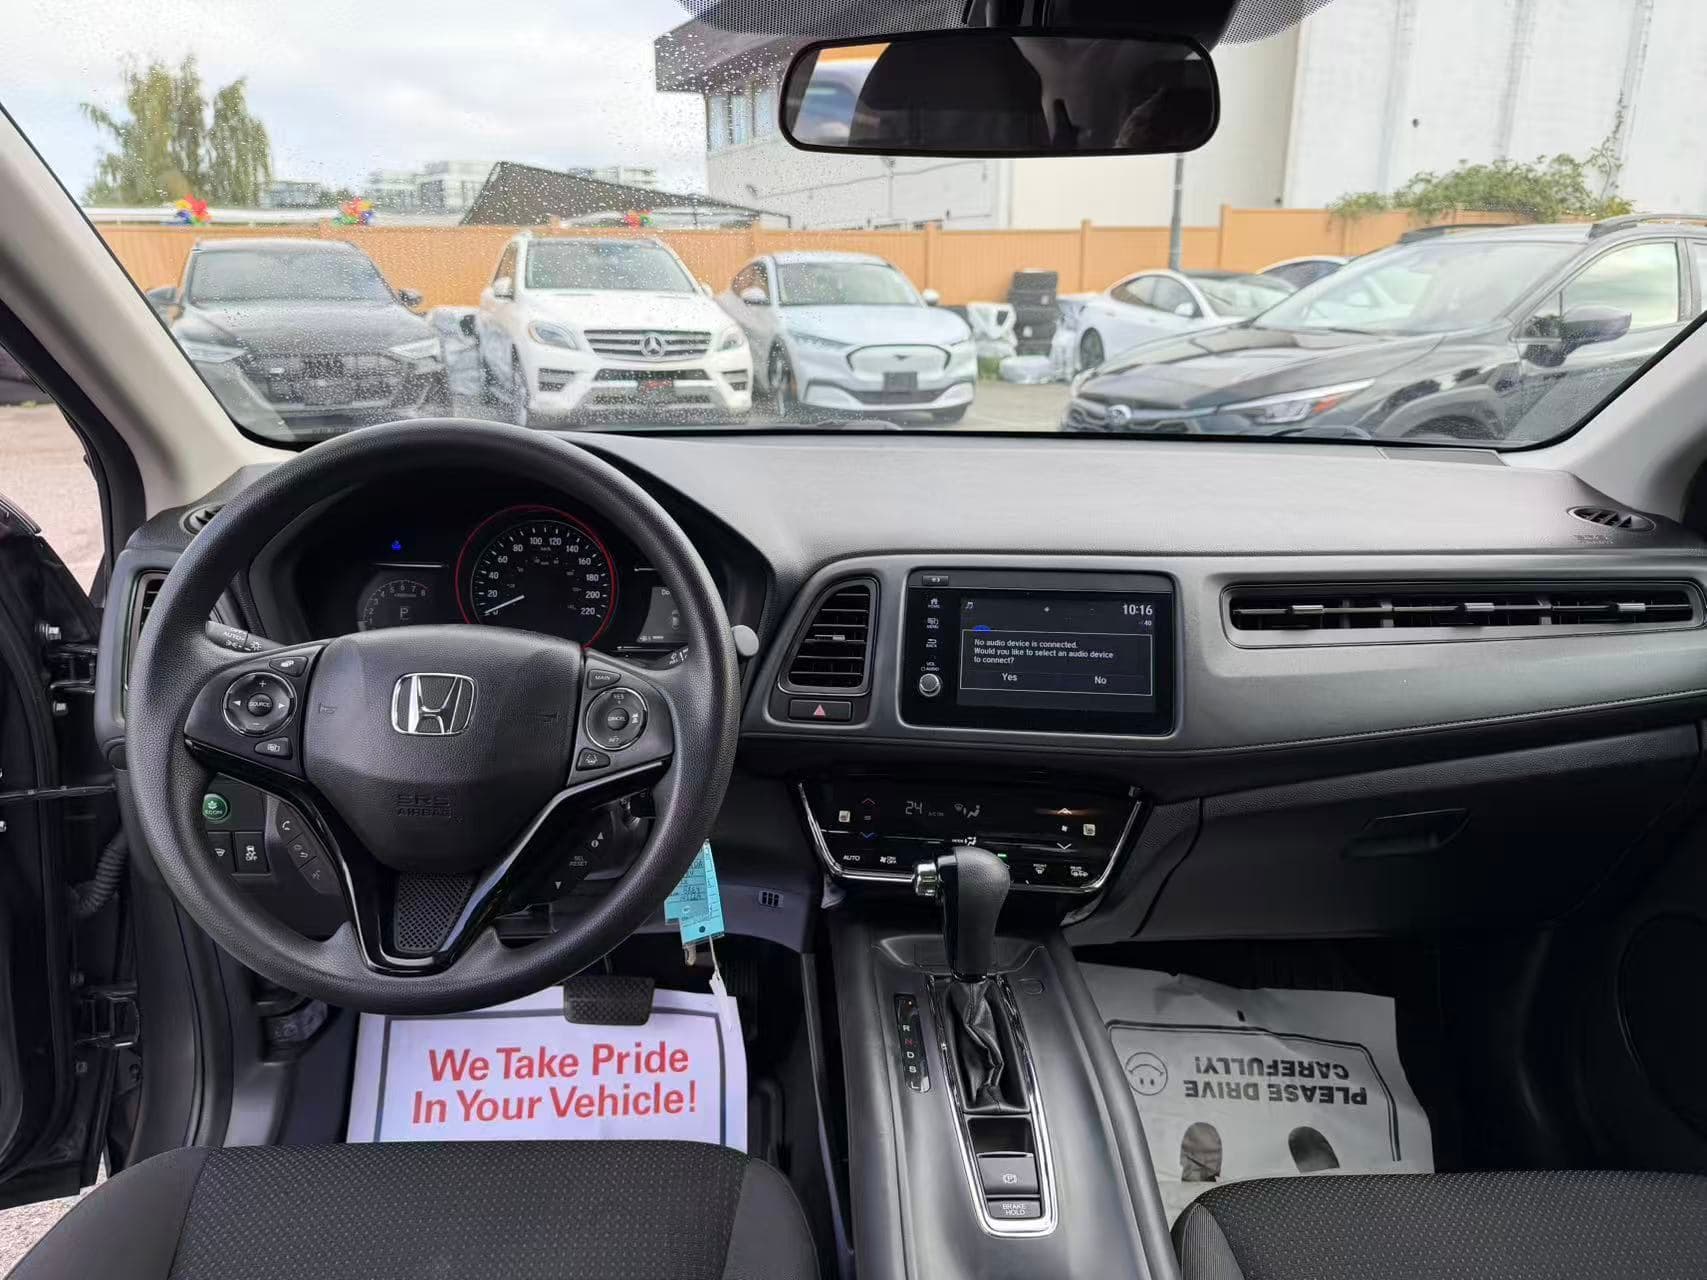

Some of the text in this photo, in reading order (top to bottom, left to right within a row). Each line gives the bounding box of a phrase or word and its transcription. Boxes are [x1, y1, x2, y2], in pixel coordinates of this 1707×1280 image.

[530, 537, 542, 545] 100
[549, 537, 562, 545] 120
[512, 544, 523, 552] 80
[566, 545, 579, 553] 140
[497, 555, 508, 563] 60
[578, 557, 591, 565] 160
[489, 572, 499, 580] 40
[586, 574, 599, 582] 180
[487, 590, 498, 598] 20
[585, 591, 600, 599] 200
[580, 607, 595, 615] 220
[1122, 604, 1153, 615] 10:16
[974, 647, 996, 655] Would
[1068, 650, 1088, 658] audio
[1002, 672, 1018, 681] Yes
[1094, 676, 1107, 684] No
[905, 800, 923, 815] 24
[902, 1024, 911, 1032] R
[906, 1051, 915, 1059] D
[428, 1041, 689, 1082] We Take Pride
[1194, 1055, 1350, 1080] CAREFULLY!
[1184, 1079, 1368, 1105] PLEASE DRIVE
[411, 1079, 698, 1124] In Your Vehicle!
